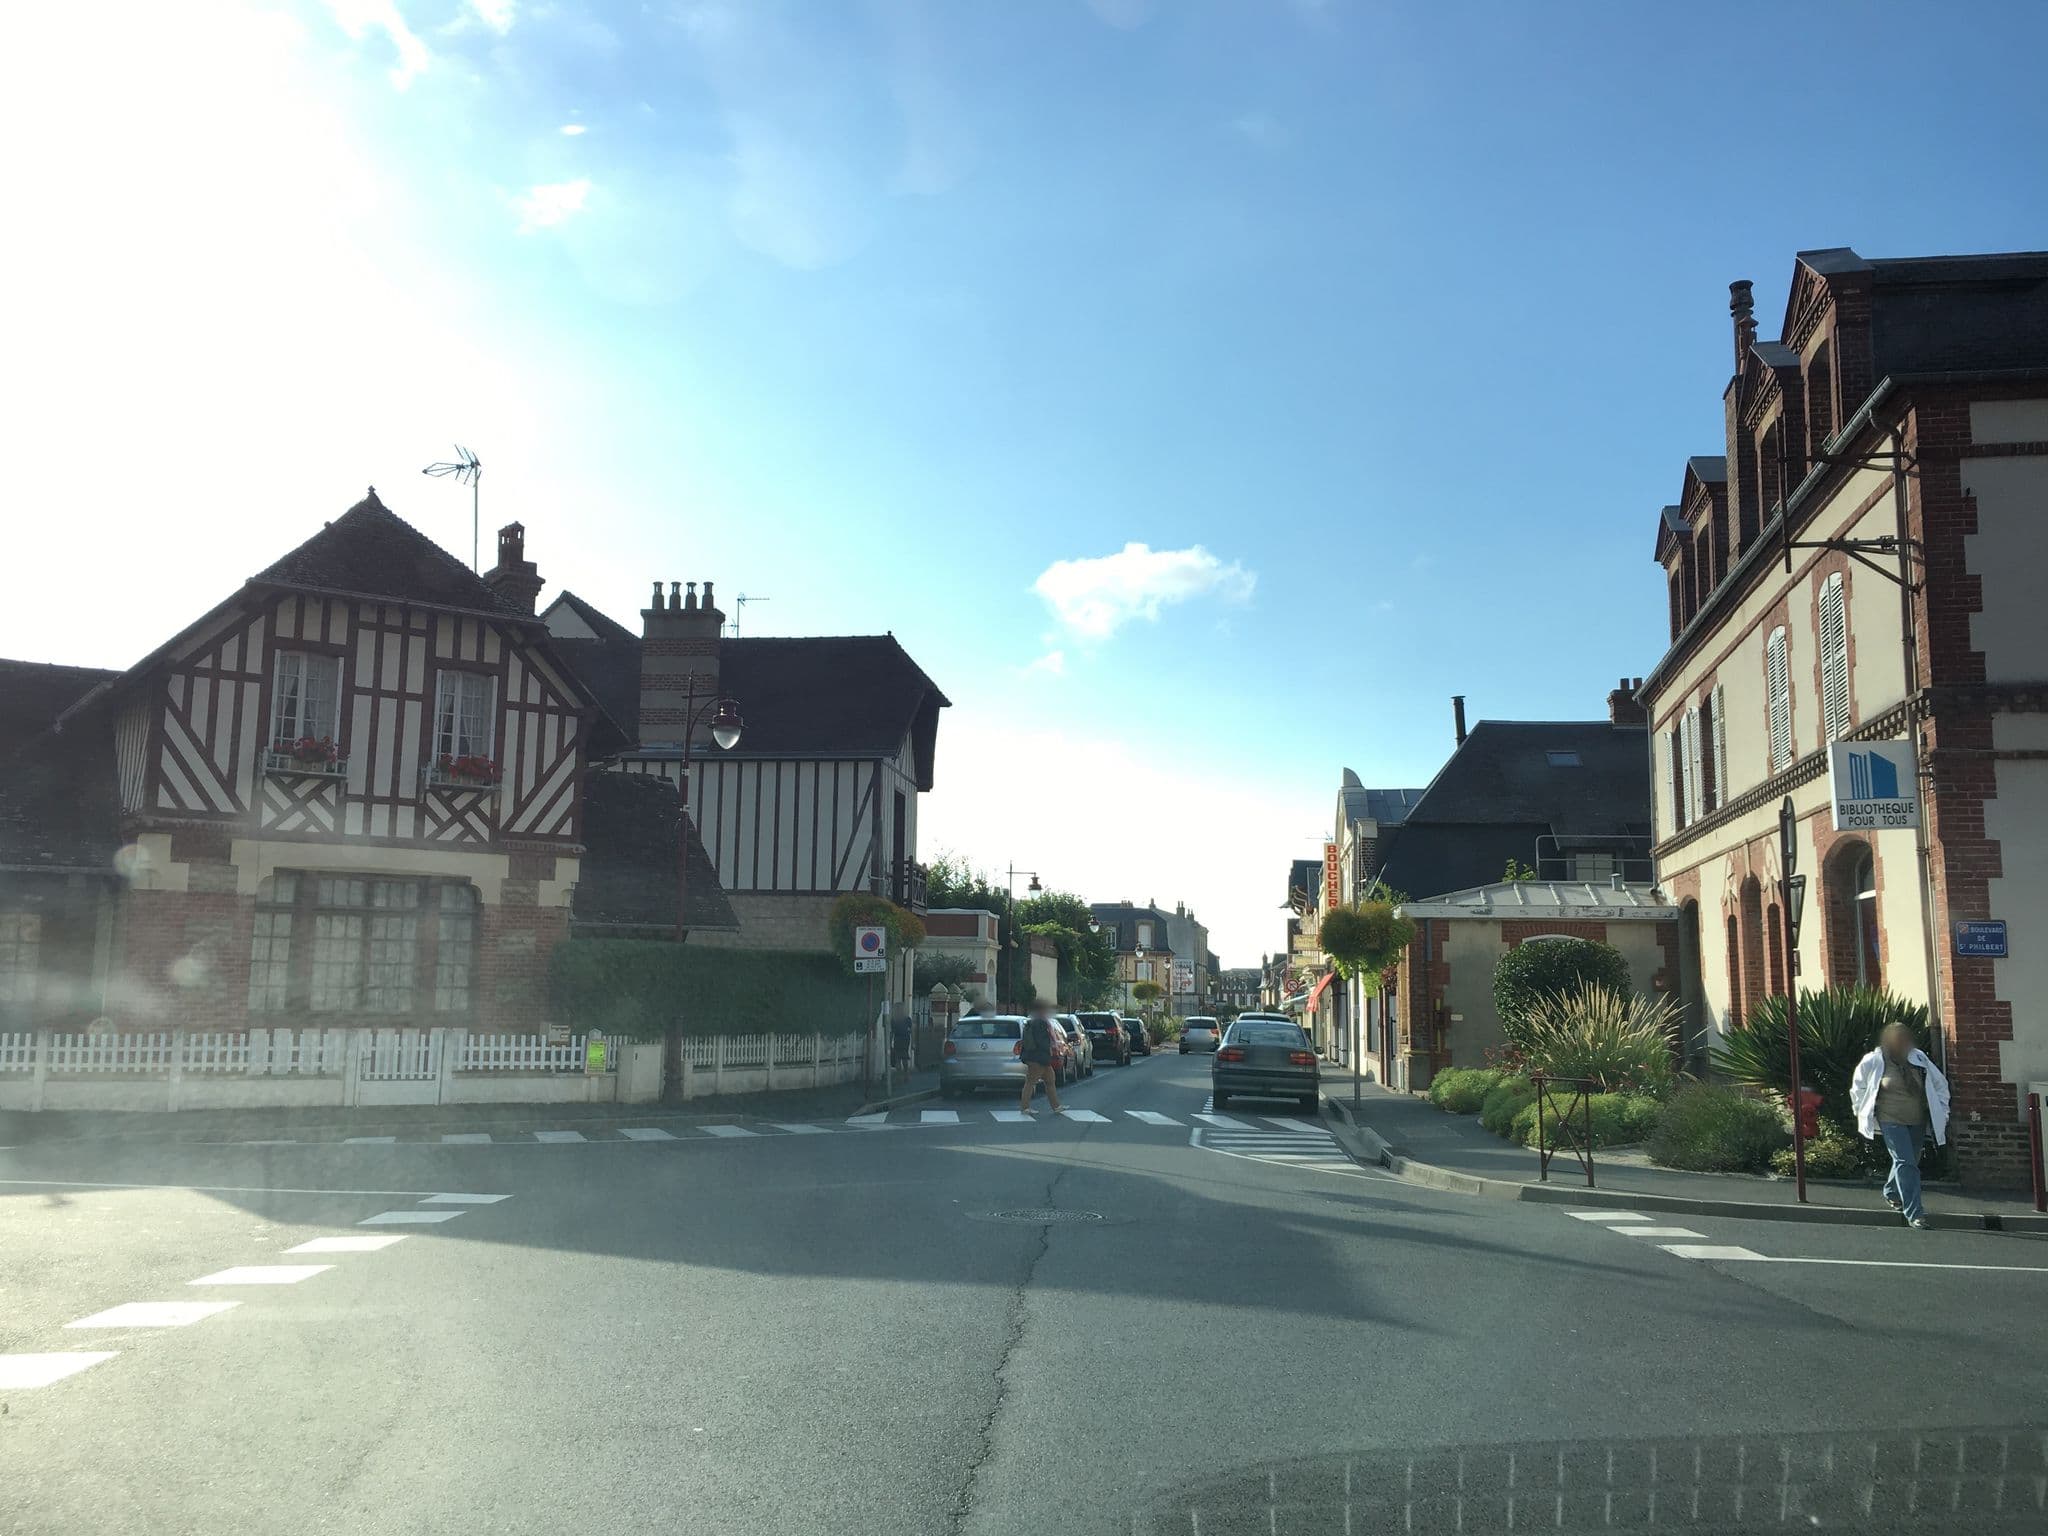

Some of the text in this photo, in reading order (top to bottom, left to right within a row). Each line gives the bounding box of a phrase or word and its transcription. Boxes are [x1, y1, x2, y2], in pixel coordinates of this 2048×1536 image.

[1840, 802, 1914, 815] BIBLIOTHEQUE
[1848, 815, 1907, 826] POUR TOUS
[1327, 845, 1338, 909] BOUCHER
